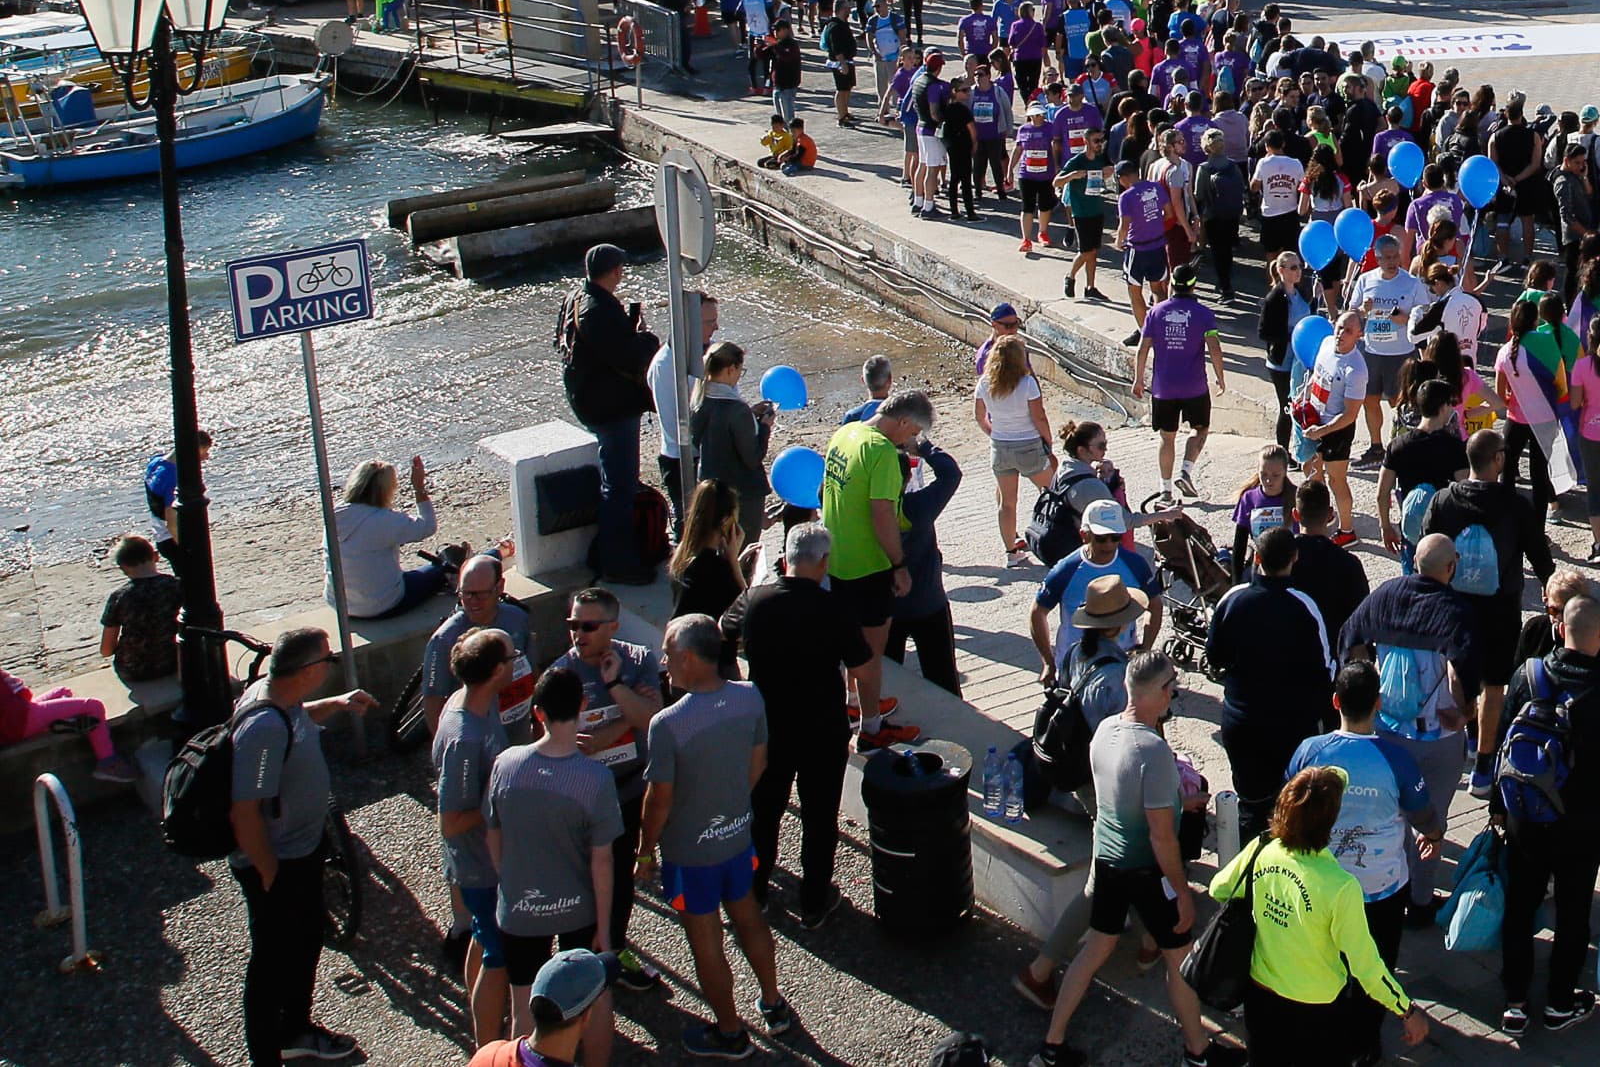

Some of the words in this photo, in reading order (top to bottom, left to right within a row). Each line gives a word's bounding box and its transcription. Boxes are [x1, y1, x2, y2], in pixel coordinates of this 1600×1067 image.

[1339, 33, 1526, 47] ogicom
[1373, 322, 1391, 332] 3490
[257, 748, 268, 789] RUNTECH
[511, 895, 581, 913] Adrenaline
[1262, 910, 1289, 928] CYPRUS
